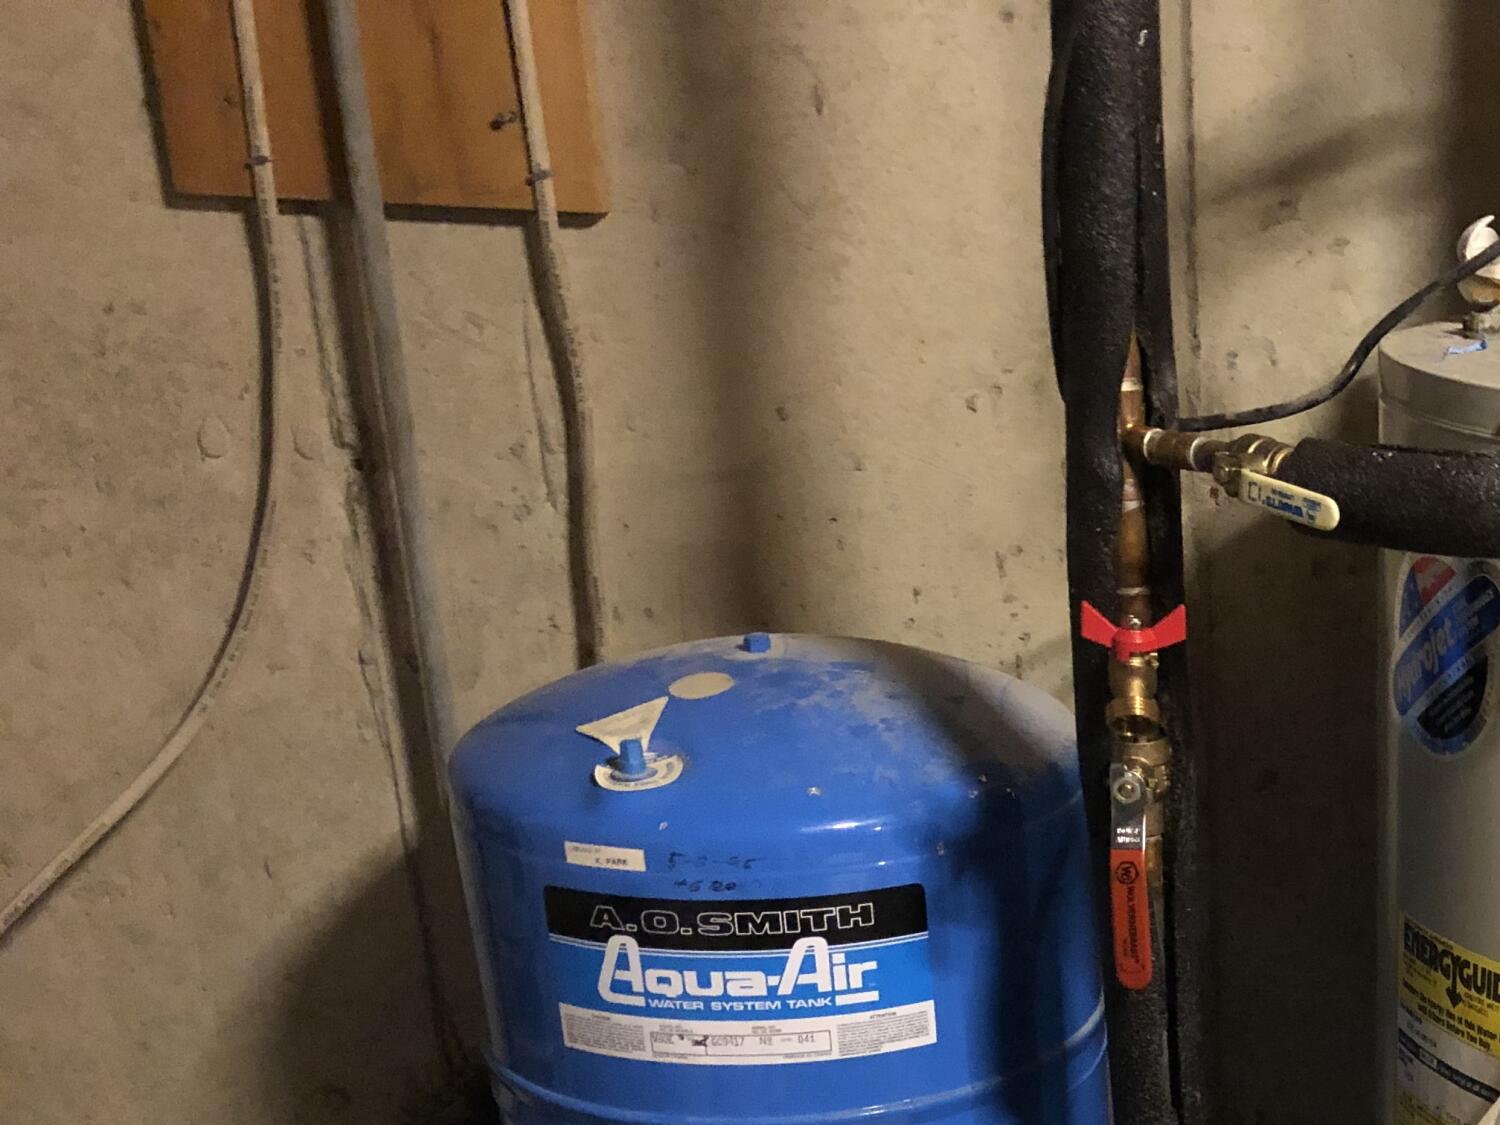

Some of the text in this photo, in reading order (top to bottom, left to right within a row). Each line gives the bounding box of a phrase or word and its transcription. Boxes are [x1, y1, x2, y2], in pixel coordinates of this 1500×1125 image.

[598, 934, 879, 1006] Aqua-Air
[649, 997, 832, 1011] WATER SYSTEM TANK
